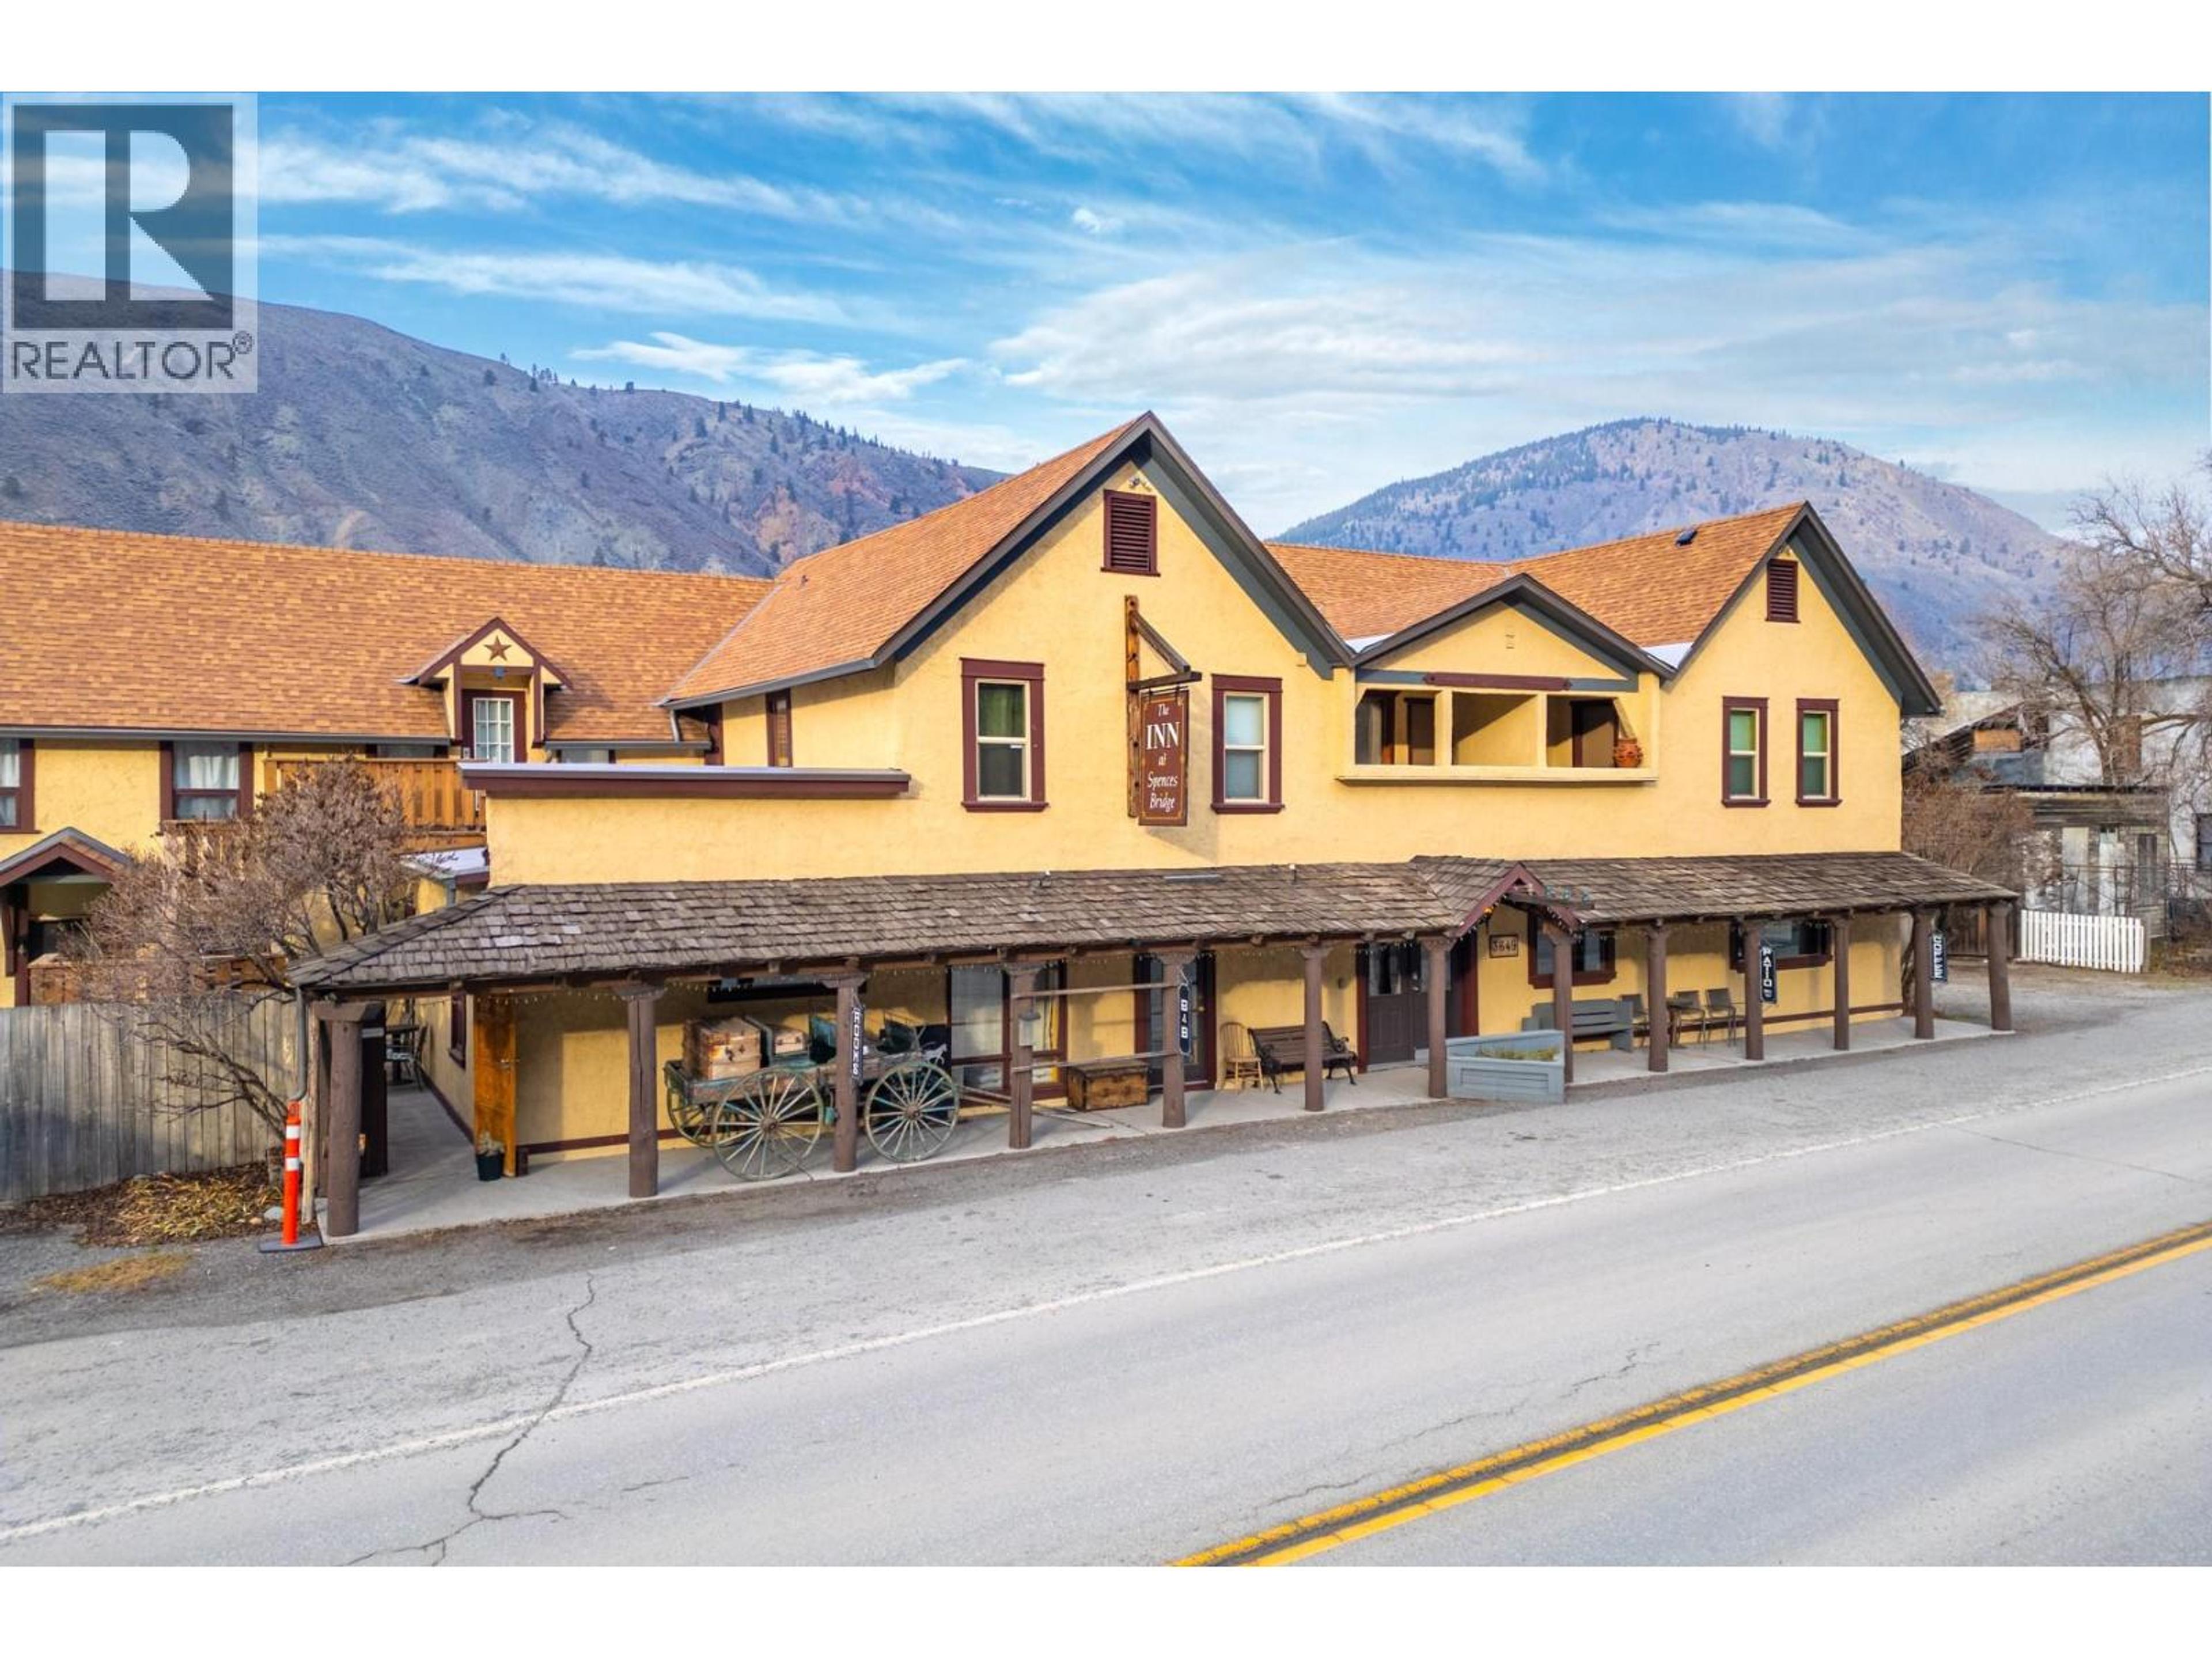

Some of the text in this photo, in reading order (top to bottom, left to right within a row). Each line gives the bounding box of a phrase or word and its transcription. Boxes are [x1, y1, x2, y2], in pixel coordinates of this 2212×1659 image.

[1158, 703, 1169, 717] The
[1146, 721, 1180, 750] INN
[1158, 752, 1166, 766] at
[1147, 771, 1178, 791] Spences
[1150, 792, 1175, 812] Bridge
